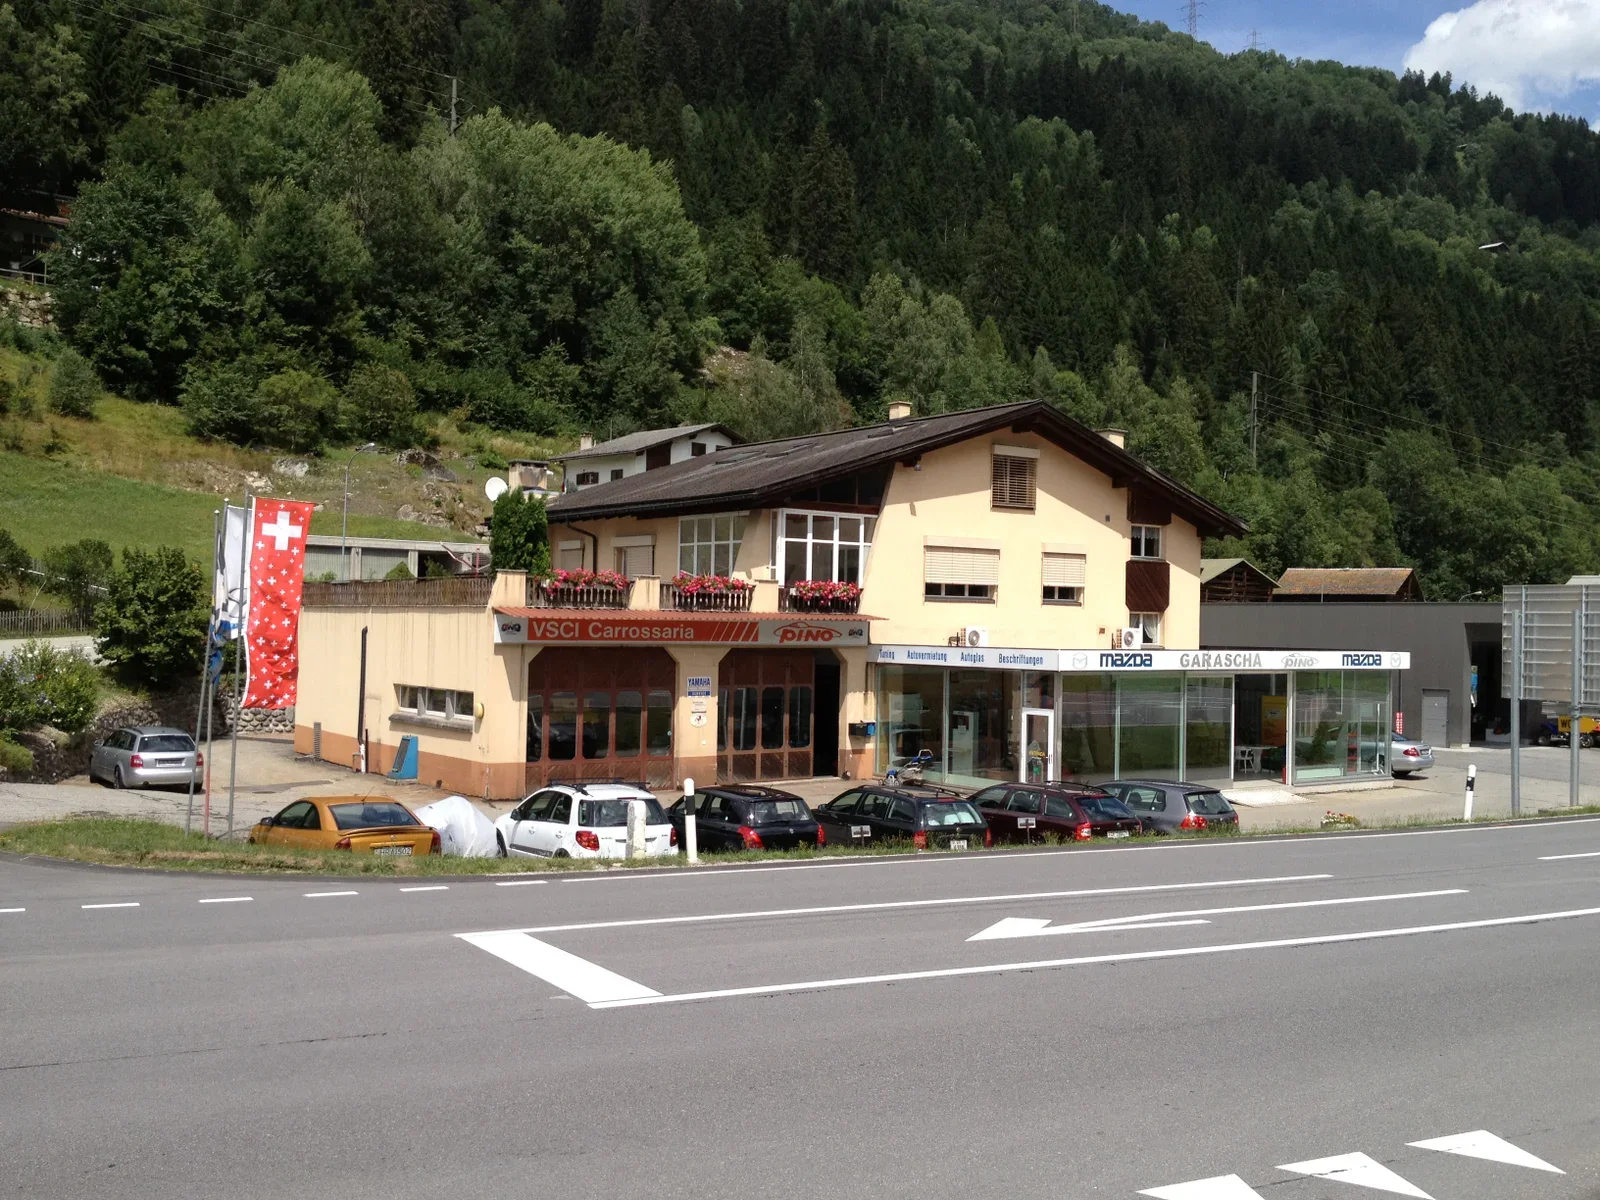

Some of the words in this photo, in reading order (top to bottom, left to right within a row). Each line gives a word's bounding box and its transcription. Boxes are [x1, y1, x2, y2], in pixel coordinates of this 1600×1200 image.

[532, 621, 579, 638] VSCI
[588, 623, 694, 639] Carrossaria
[879, 649, 895, 660] Tuning
[907, 650, 947, 662] Autovermietung
[960, 651, 985, 663] Autoglas
[998, 653, 1044, 665] Beschriftungen
[1100, 653, 1153, 667] mazda
[1179, 653, 1262, 668] GARASCHA
[1342, 653, 1382, 667] mazda
[688, 677, 710, 687] YAMAHA
